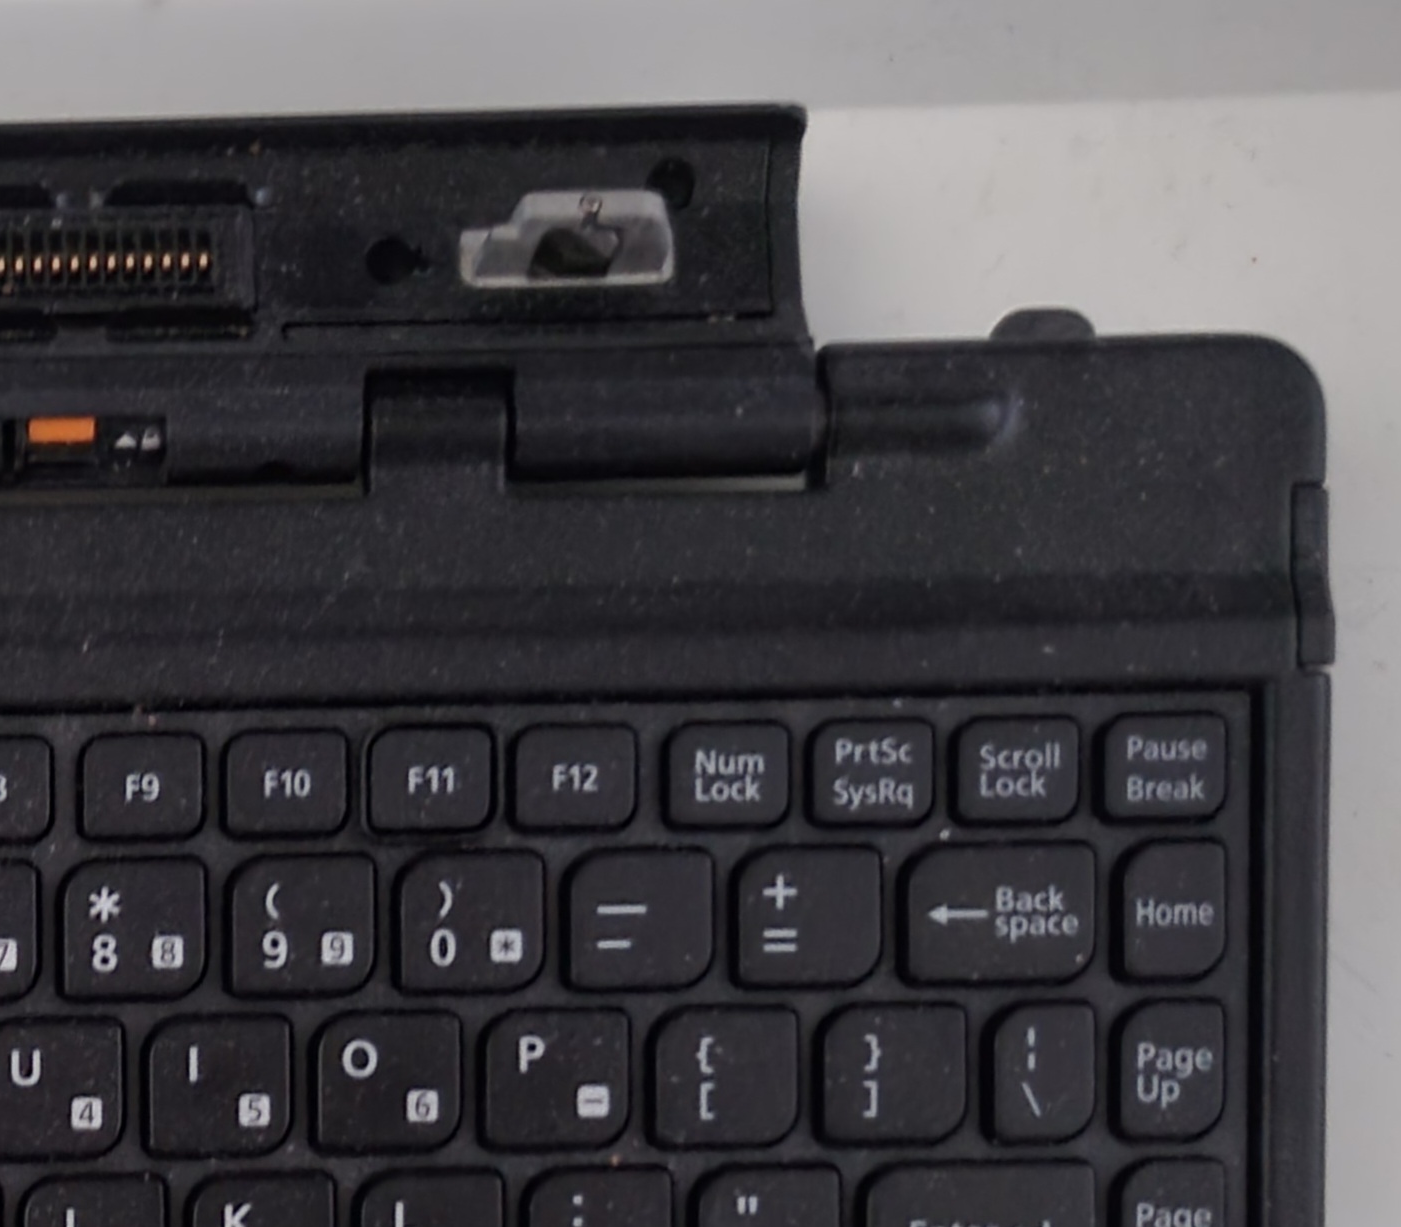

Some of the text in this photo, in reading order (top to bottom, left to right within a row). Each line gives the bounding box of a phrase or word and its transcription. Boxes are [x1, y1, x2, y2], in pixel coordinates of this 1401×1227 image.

[695, 750, 764, 776] Num
[836, 738, 910, 764] PrtSc
[980, 743, 1060, 773] Scroll
[1127, 736, 1206, 760] Pause
[126, 774, 159, 801] F9
[265, 770, 310, 797] F10
[409, 767, 454, 793] F11
[553, 765, 598, 791] F12
[696, 777, 759, 801] Lock
[834, 778, 913, 810] SysRq
[981, 772, 1045, 796] Lock
[1127, 776, 1203, 801] Break
[266, 884, 278, 919] (
[440, 882, 452, 917] )
[763, 875, 797, 909] +
[996, 886, 1063, 912] Back
[996, 915, 1078, 942] space
[1137, 899, 1213, 926] Home
[93, 935, 117, 972] 8
[263, 931, 287, 968] 9
[763, 929, 797, 952] =
[11, 1050, 40, 1086] U
[189, 1047, 198, 1082] I
[343, 1040, 377, 1078] O
[519, 1036, 545, 1072] P
[697, 1037, 713, 1074] {
[865, 1034, 881, 1072] }
[1138, 1043, 1212, 1079] Page
[700, 1082, 714, 1120] [
[864, 1080, 878, 1118] ]
[1022, 1082, 1041, 1116] \
[1137, 1075, 1180, 1108] Up
